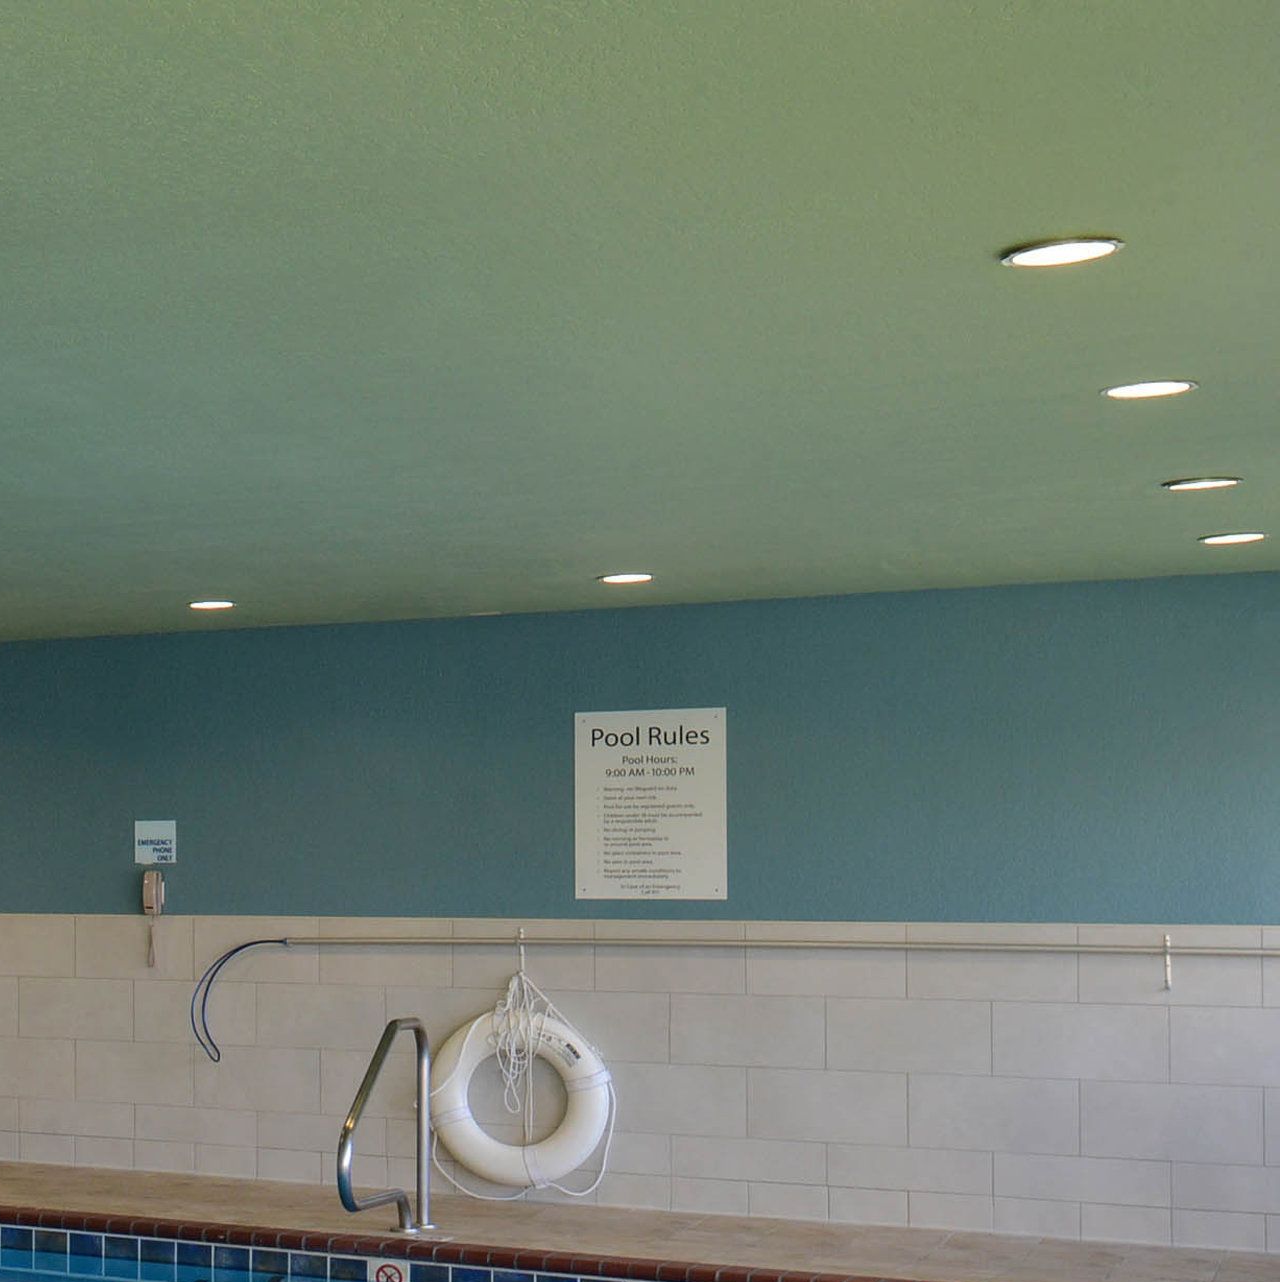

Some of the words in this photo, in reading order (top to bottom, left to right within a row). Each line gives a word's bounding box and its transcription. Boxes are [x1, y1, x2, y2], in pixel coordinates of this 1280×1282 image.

[591, 726, 640, 747] Pool
[648, 725, 710, 746] Rules
[622, 755, 643, 765] Pool
[646, 755, 677, 764] Hours:
[605, 768, 626, 777] 9:00
[629, 768, 645, 776] AM
[652, 767, 677, 777] 10:00
[680, 766, 695, 775] PM
